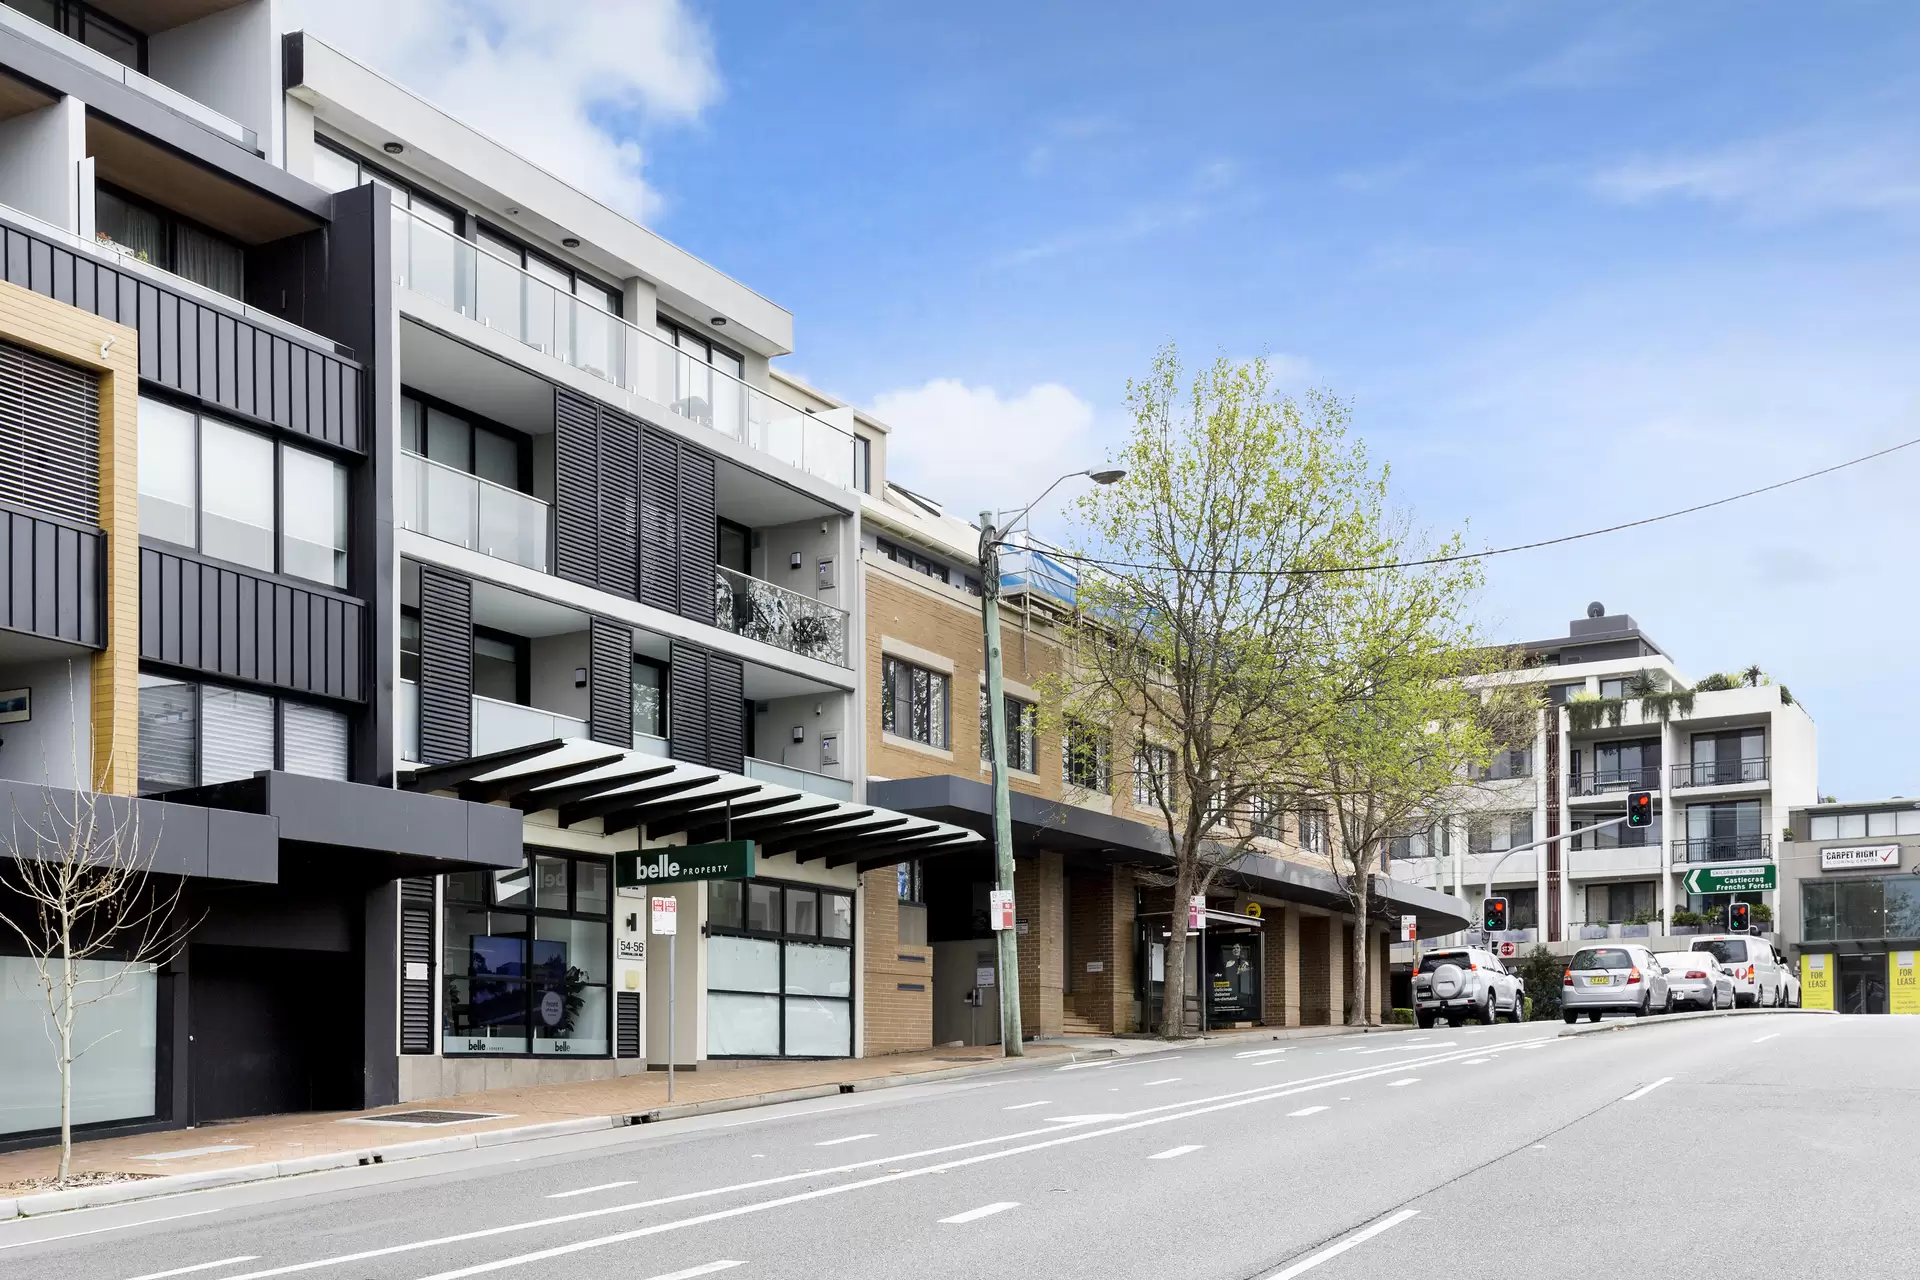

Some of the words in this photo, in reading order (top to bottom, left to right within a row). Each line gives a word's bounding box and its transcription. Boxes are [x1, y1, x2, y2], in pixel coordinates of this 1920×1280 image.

[1826, 851, 1854, 860] CARPET
[1855, 850, 1878, 858] RIGHT
[636, 854, 680, 880] belle
[683, 865, 728, 875] PROPERTY
[620, 941, 644, 952] 54-56
[1899, 968, 1912, 976] FOR
[1808, 980, 1827, 988] LEASE
[1896, 977, 1916, 985] LEASE
[468, 1039, 486, 1051] belle
[554, 1041, 571, 1052] belle
